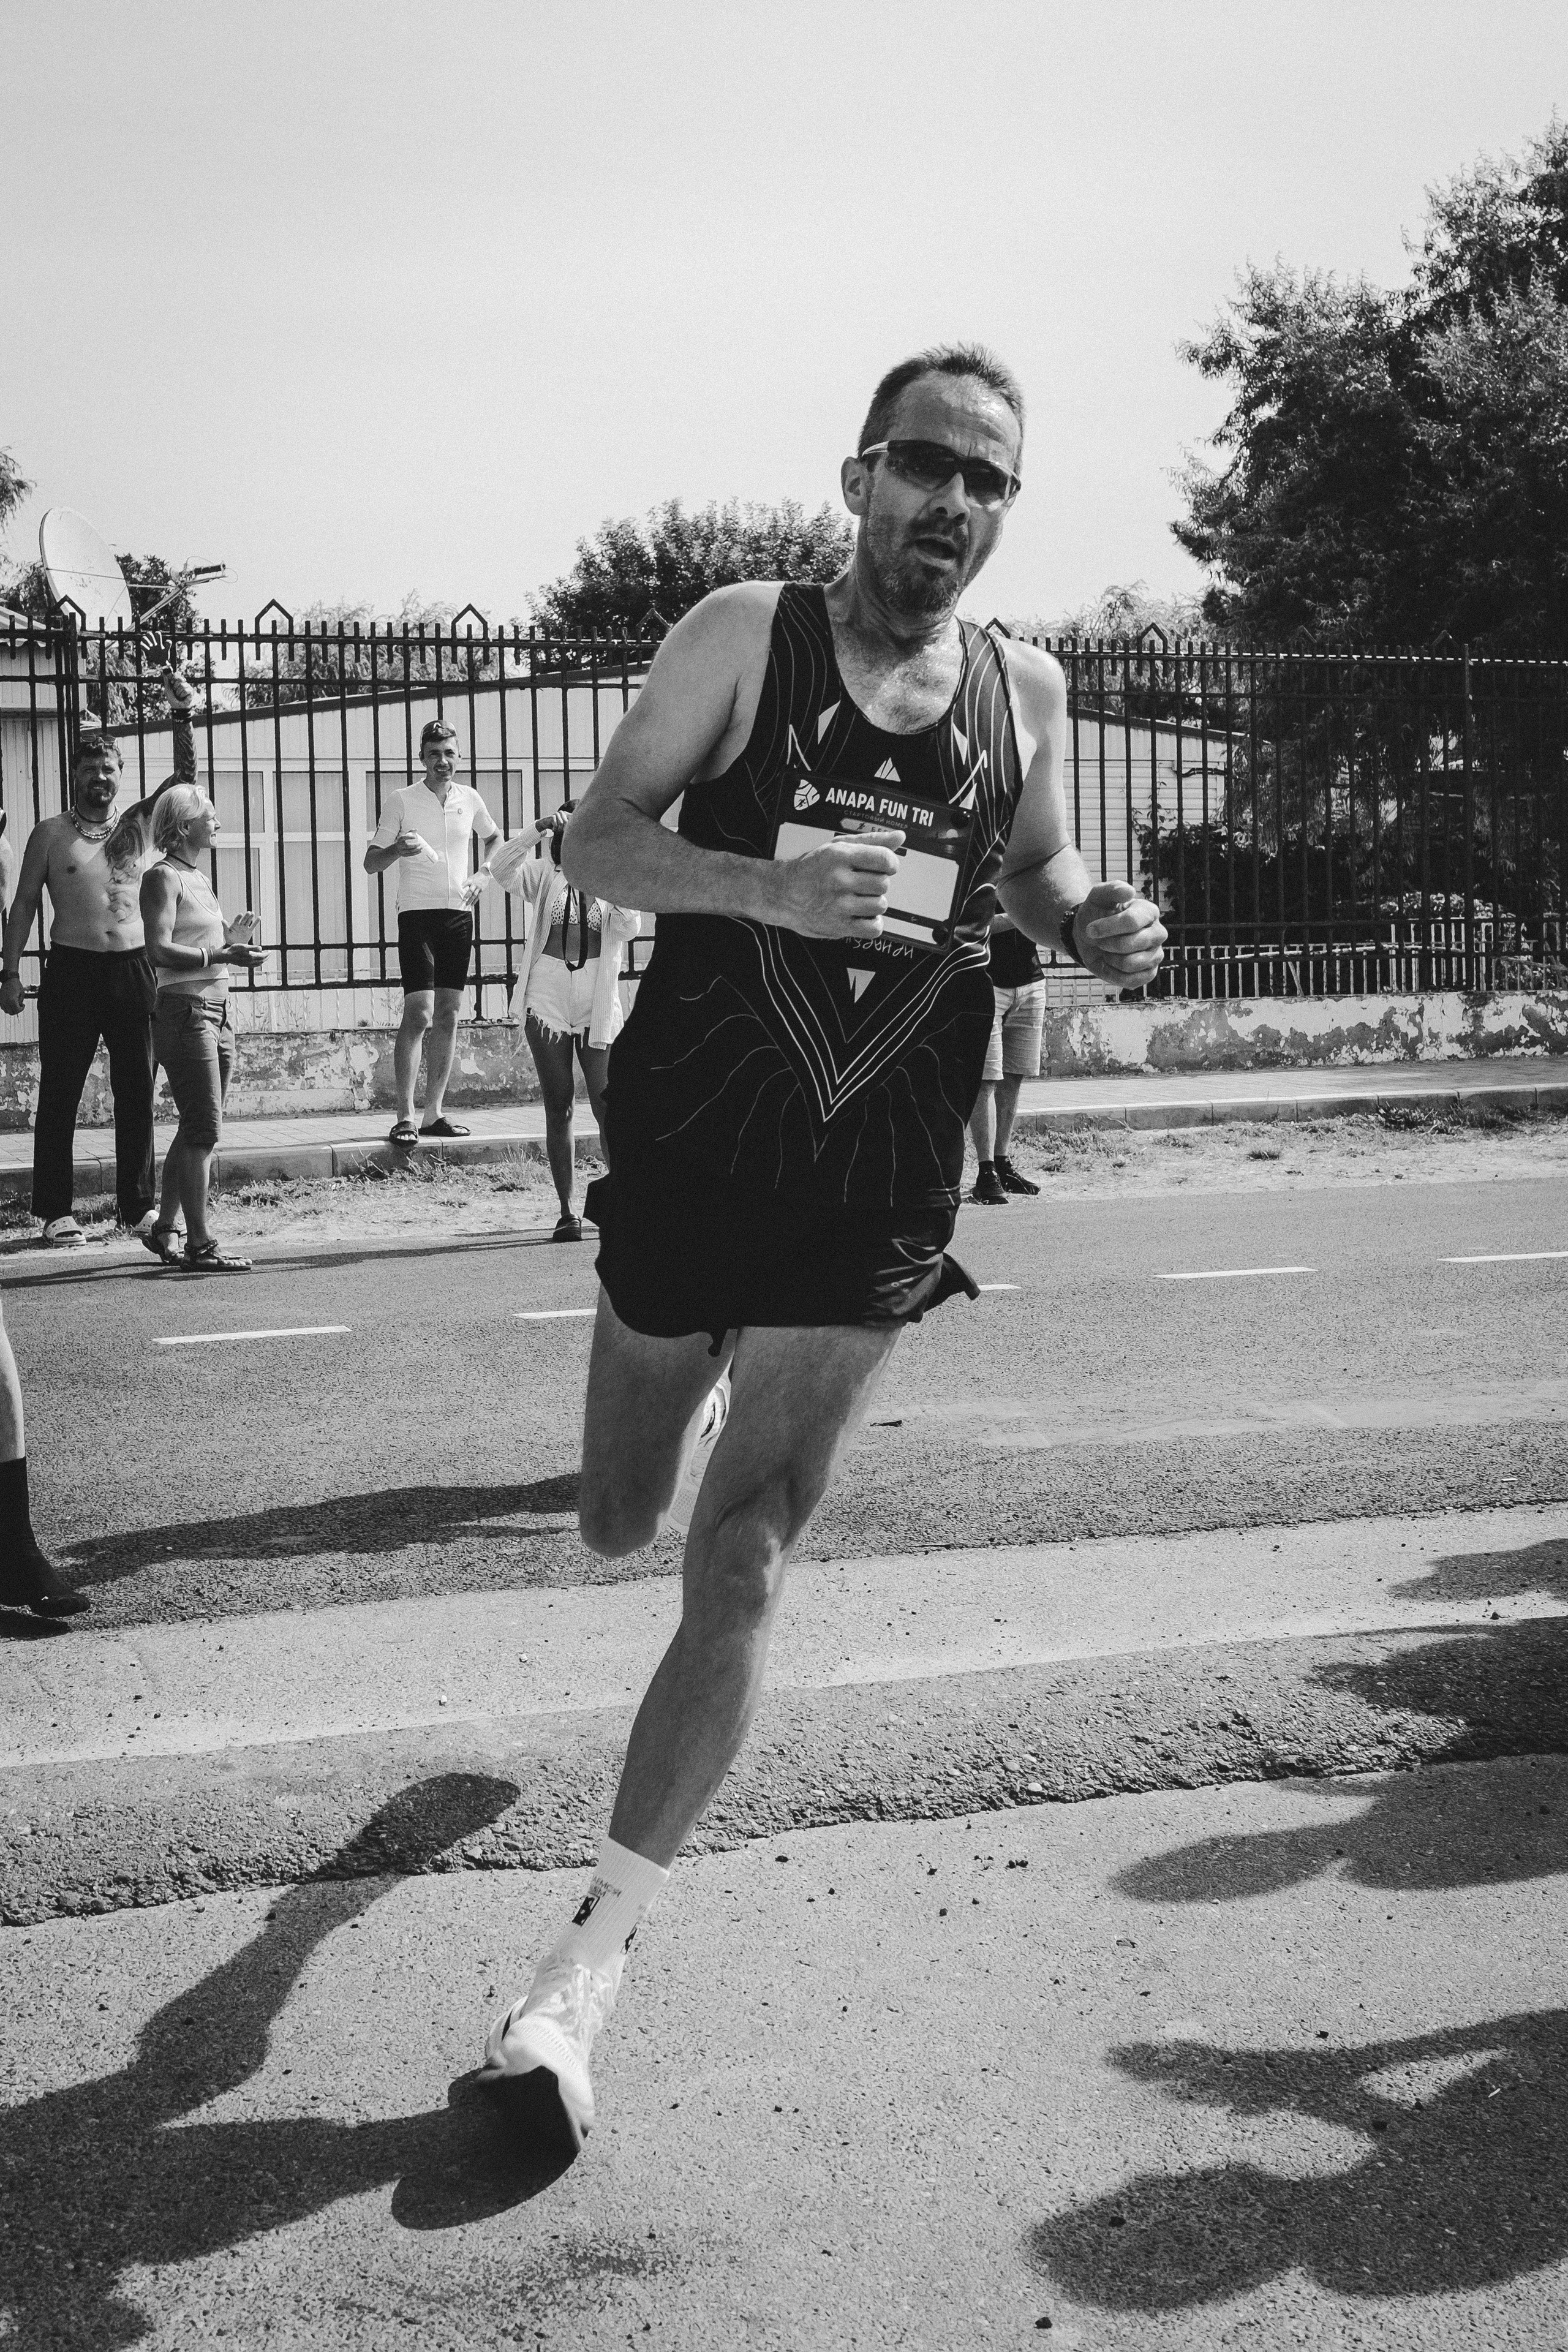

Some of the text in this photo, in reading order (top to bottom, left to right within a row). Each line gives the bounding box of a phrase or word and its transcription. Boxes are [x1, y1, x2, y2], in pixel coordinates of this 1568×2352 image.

[825, 787, 934, 827] ANAPA FUN TRI
[844, 809, 908, 829] СТАРТОВЫЙ НОМЕР
